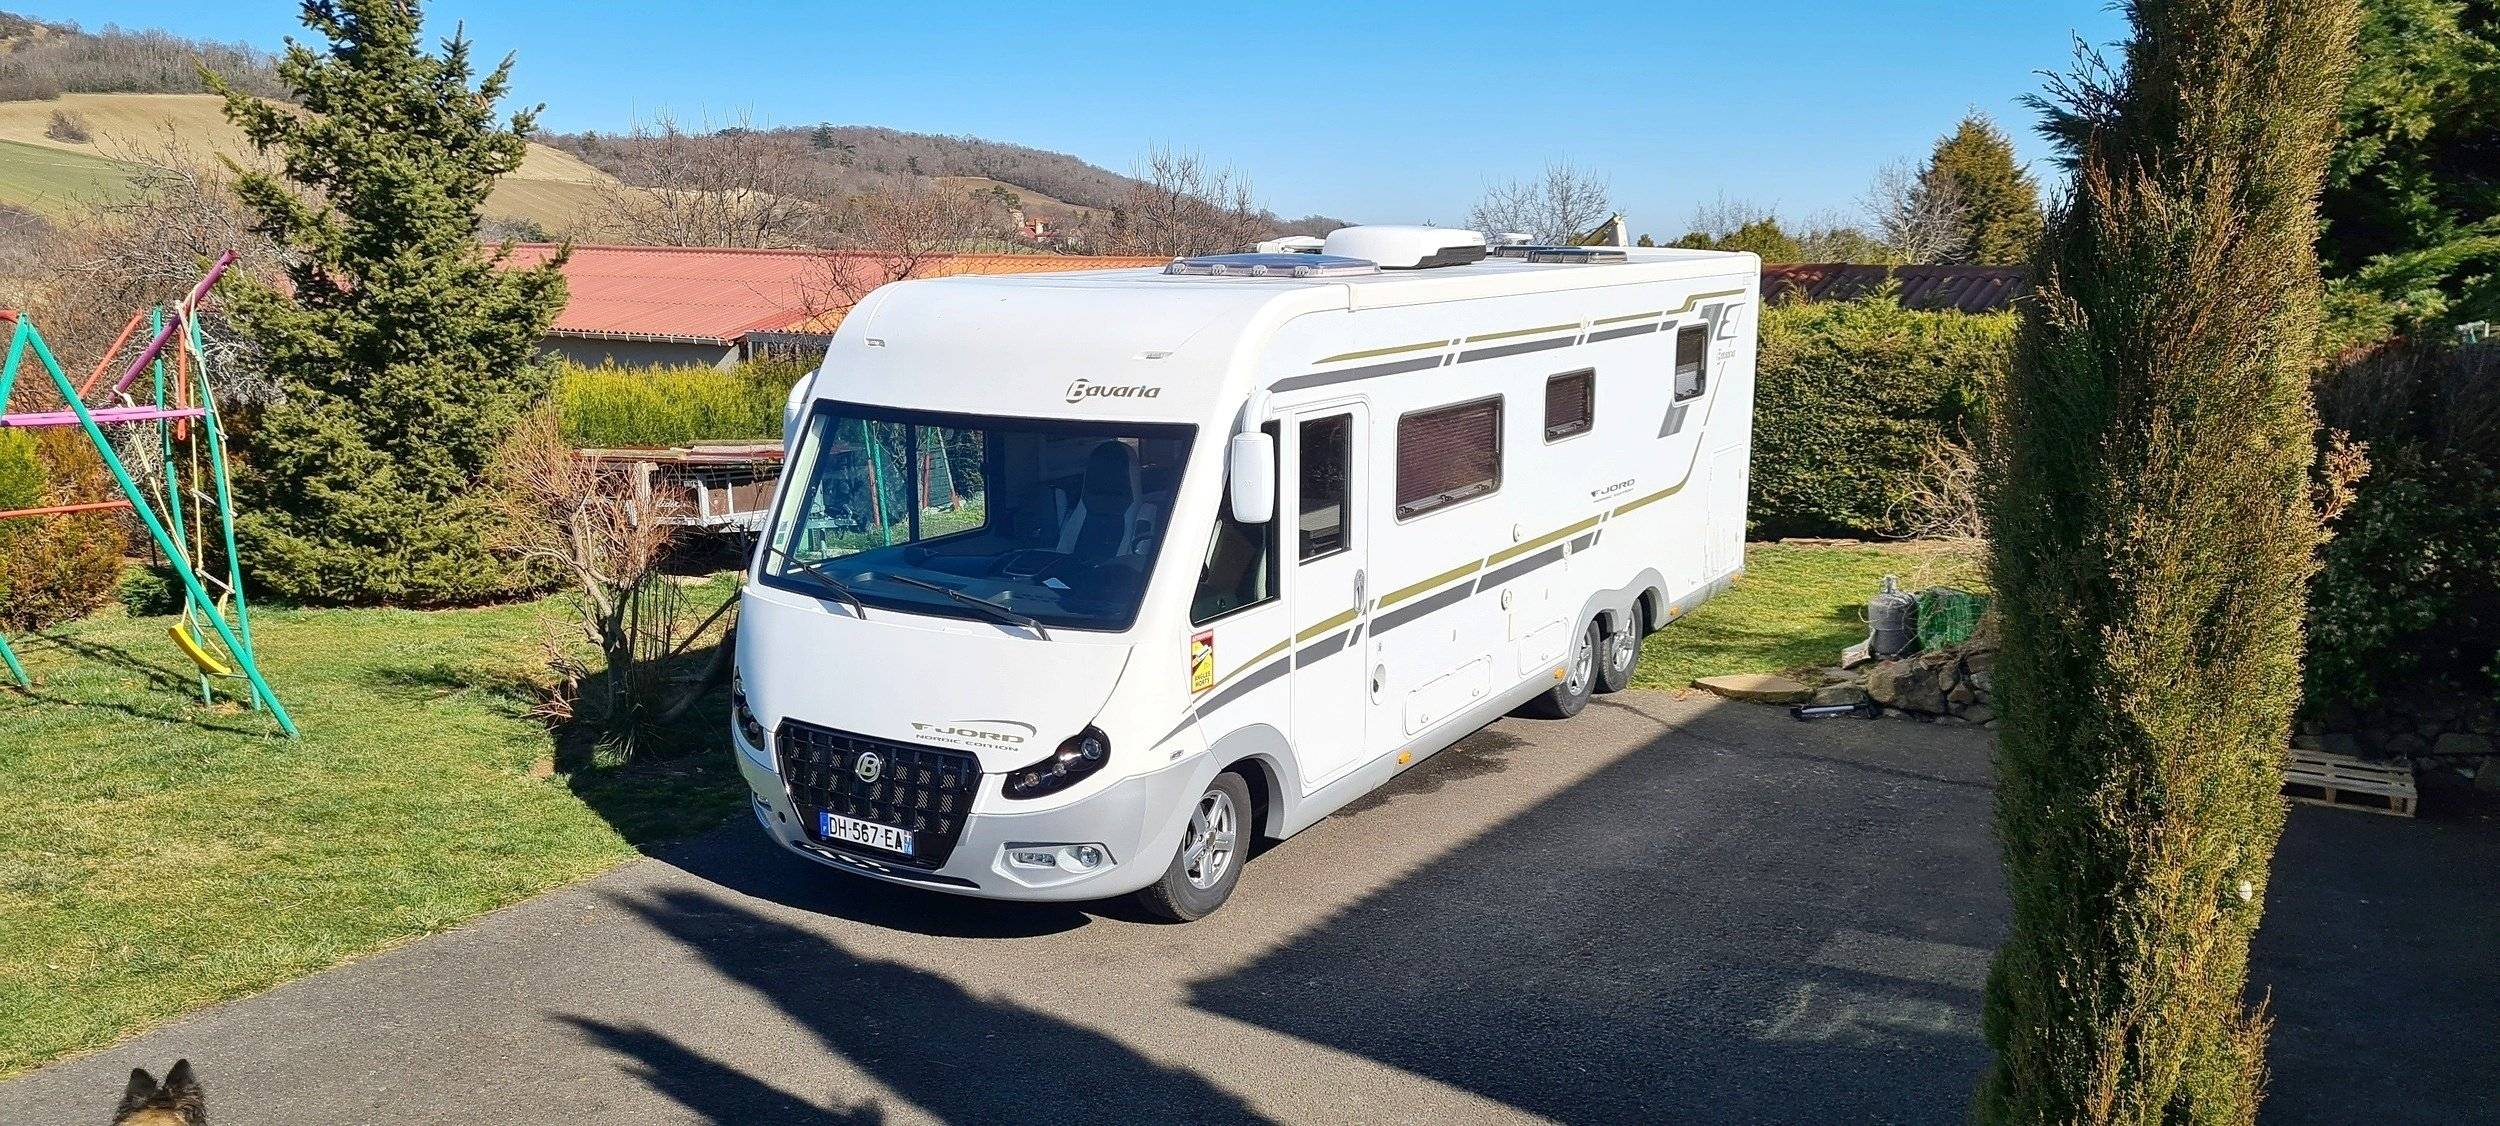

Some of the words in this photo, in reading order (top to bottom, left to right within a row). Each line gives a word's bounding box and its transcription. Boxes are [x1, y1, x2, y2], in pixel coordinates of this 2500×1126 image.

[1065, 378, 1161, 404] Bavaria
[1591, 479, 1635, 497] FJORD
[911, 722, 1025, 743] FJORD
[916, 734, 961, 743] NORDIC
[965, 741, 1019, 752] EDITION
[858, 754, 880, 780] B
[829, 816, 903, 851] DH-567-EA
